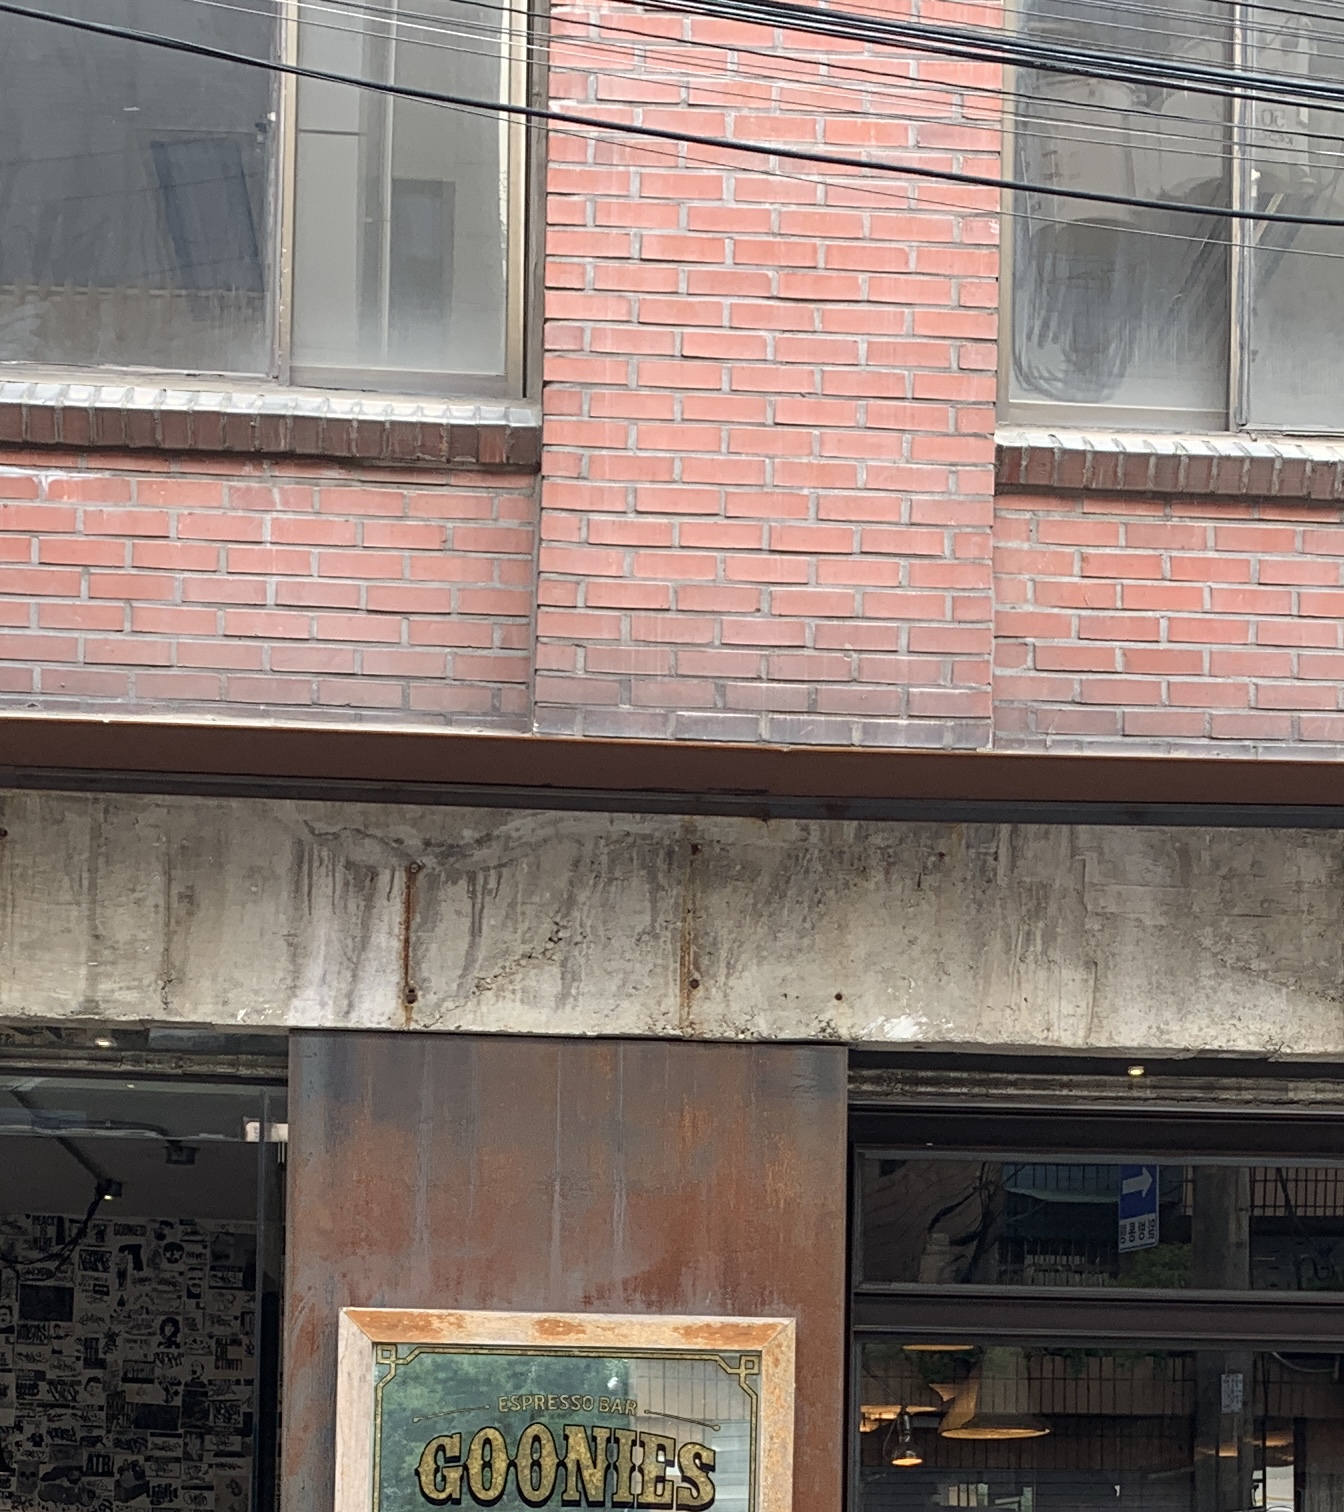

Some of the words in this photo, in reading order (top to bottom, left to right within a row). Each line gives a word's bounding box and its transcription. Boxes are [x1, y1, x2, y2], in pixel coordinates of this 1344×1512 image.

[498, 1394, 594, 1412] ESPRESSO
[598, 1396, 637, 1415] BAR
[414, 1422, 716, 1512] GOONIES
